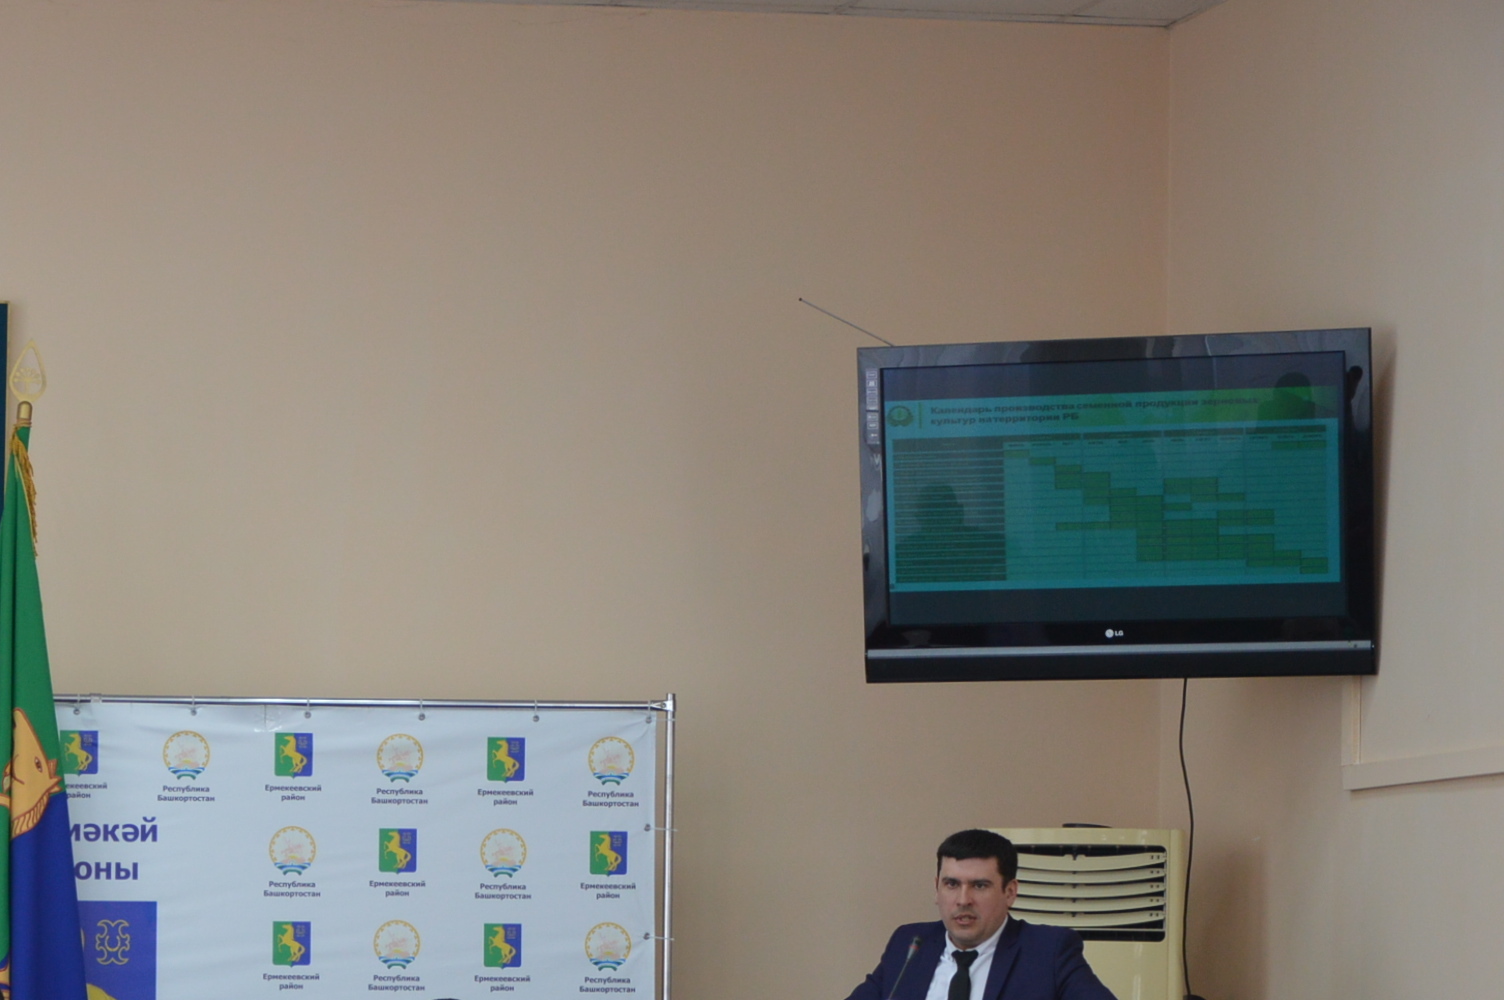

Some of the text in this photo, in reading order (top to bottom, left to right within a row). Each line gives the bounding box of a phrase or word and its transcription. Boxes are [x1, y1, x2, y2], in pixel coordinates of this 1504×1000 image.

[1113, 629, 1125, 637] LG
[162, 784, 211, 794] Республика
[264, 783, 323, 793] Ермекеевский
[375, 787, 424, 797] Республика
[476, 788, 534, 798] Ермекеевский
[156, 794, 216, 803] Башкортостан
[280, 793, 306, 802] район
[587, 790, 635, 800] Республика
[370, 796, 429, 806] Башкортостан
[492, 797, 518, 807] район
[582, 799, 640, 809] Башкортостан
[74, 861, 139, 881] оны
[268, 880, 317, 890] Республика
[368, 879, 427, 889] Ермекеевский
[479, 882, 527, 892] Республика
[579, 882, 637, 891] Ермекеевский
[263, 889, 322, 899] Башкортостан
[384, 888, 410, 898] район
[474, 891, 532, 901] Башкортостан
[595, 891, 621, 901] район
[262, 972, 321, 982] Ермекеевский
[372, 974, 421, 984] Республика
[473, 974, 531, 984] Ермекеевский
[584, 976, 631, 986] Республика
[278, 981, 304, 992] район
[367, 983, 426, 993] Башкортостан
[489, 983, 515, 993] район
[578, 985, 636, 995] Башкортостан
